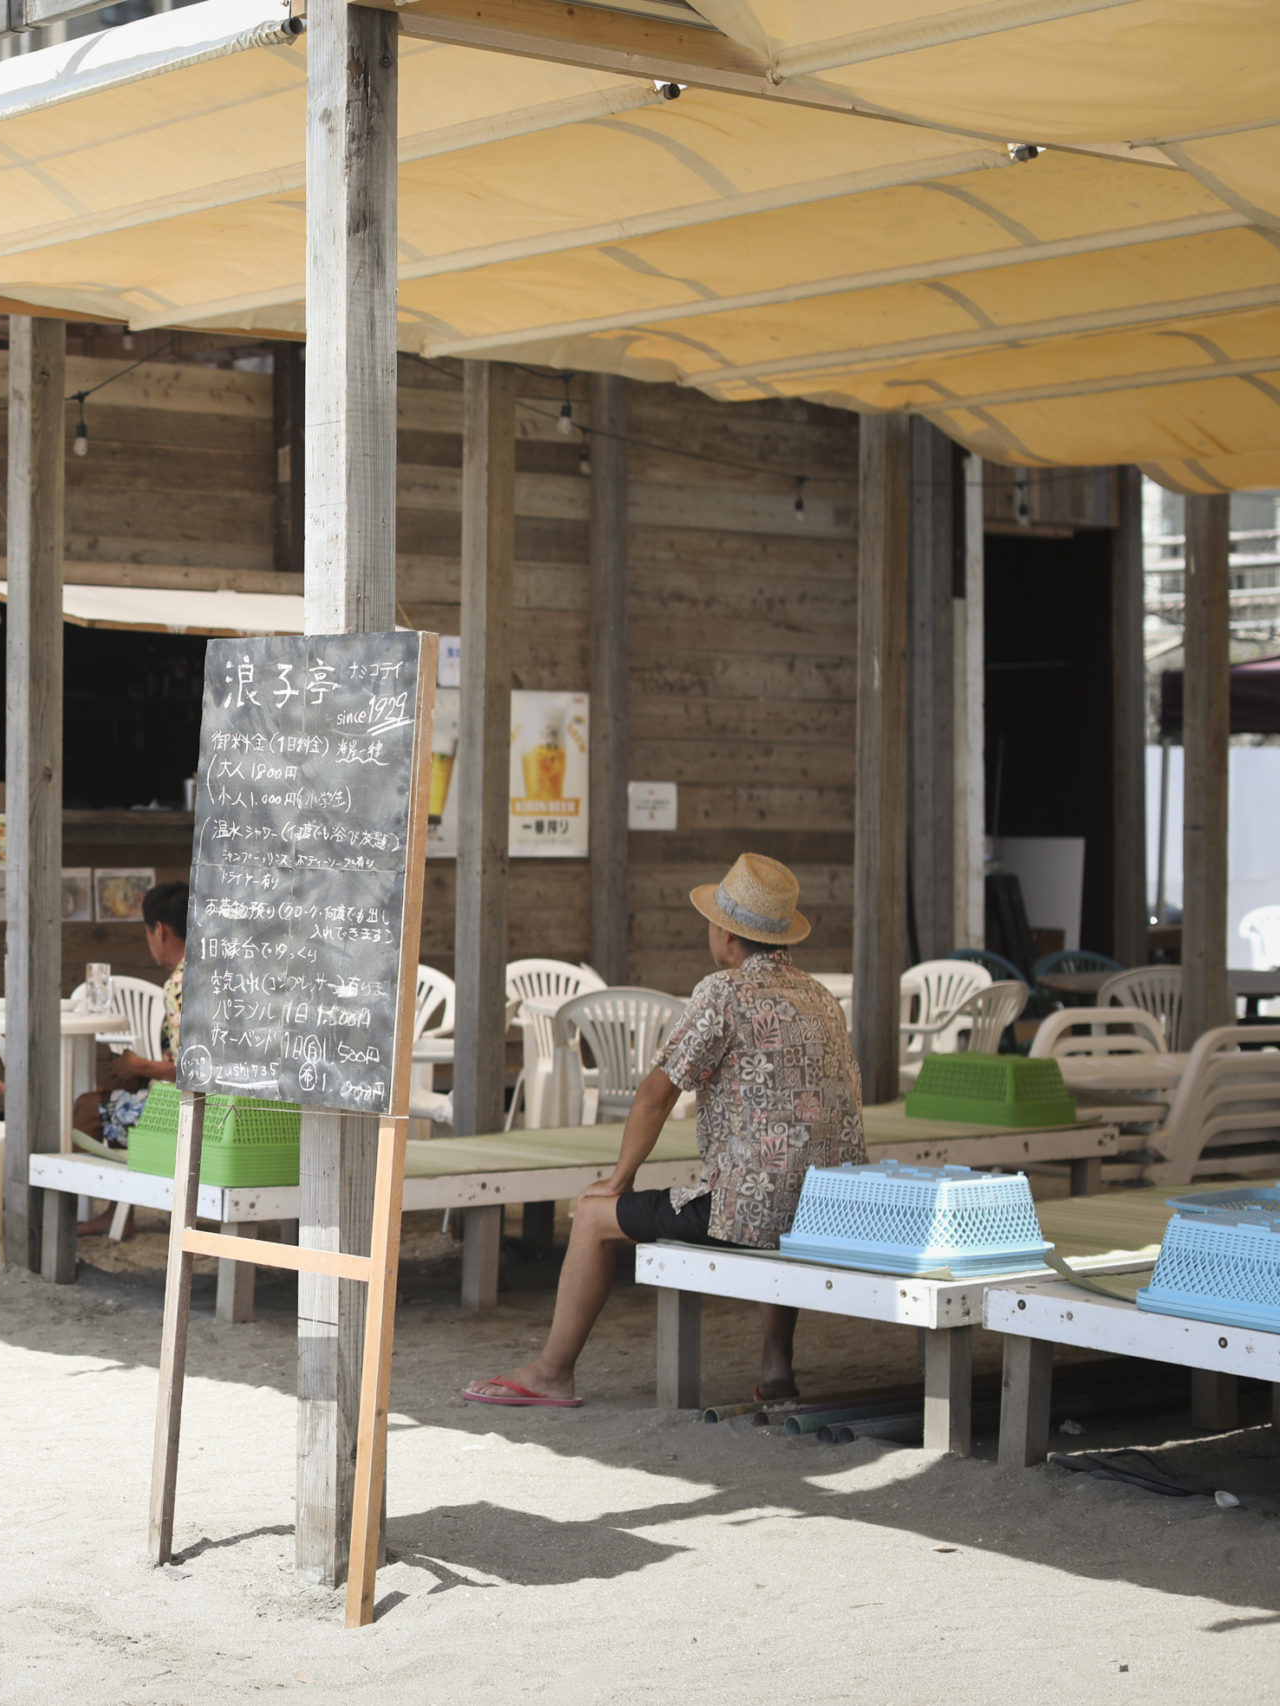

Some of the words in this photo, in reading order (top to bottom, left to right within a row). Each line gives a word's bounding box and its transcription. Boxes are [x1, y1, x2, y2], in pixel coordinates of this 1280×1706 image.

[223, 655, 341, 708] 浪子亭
[336, 709, 367, 726] since
[367, 692, 410, 724] 1929
[211, 999, 275, 1021] パラソル
